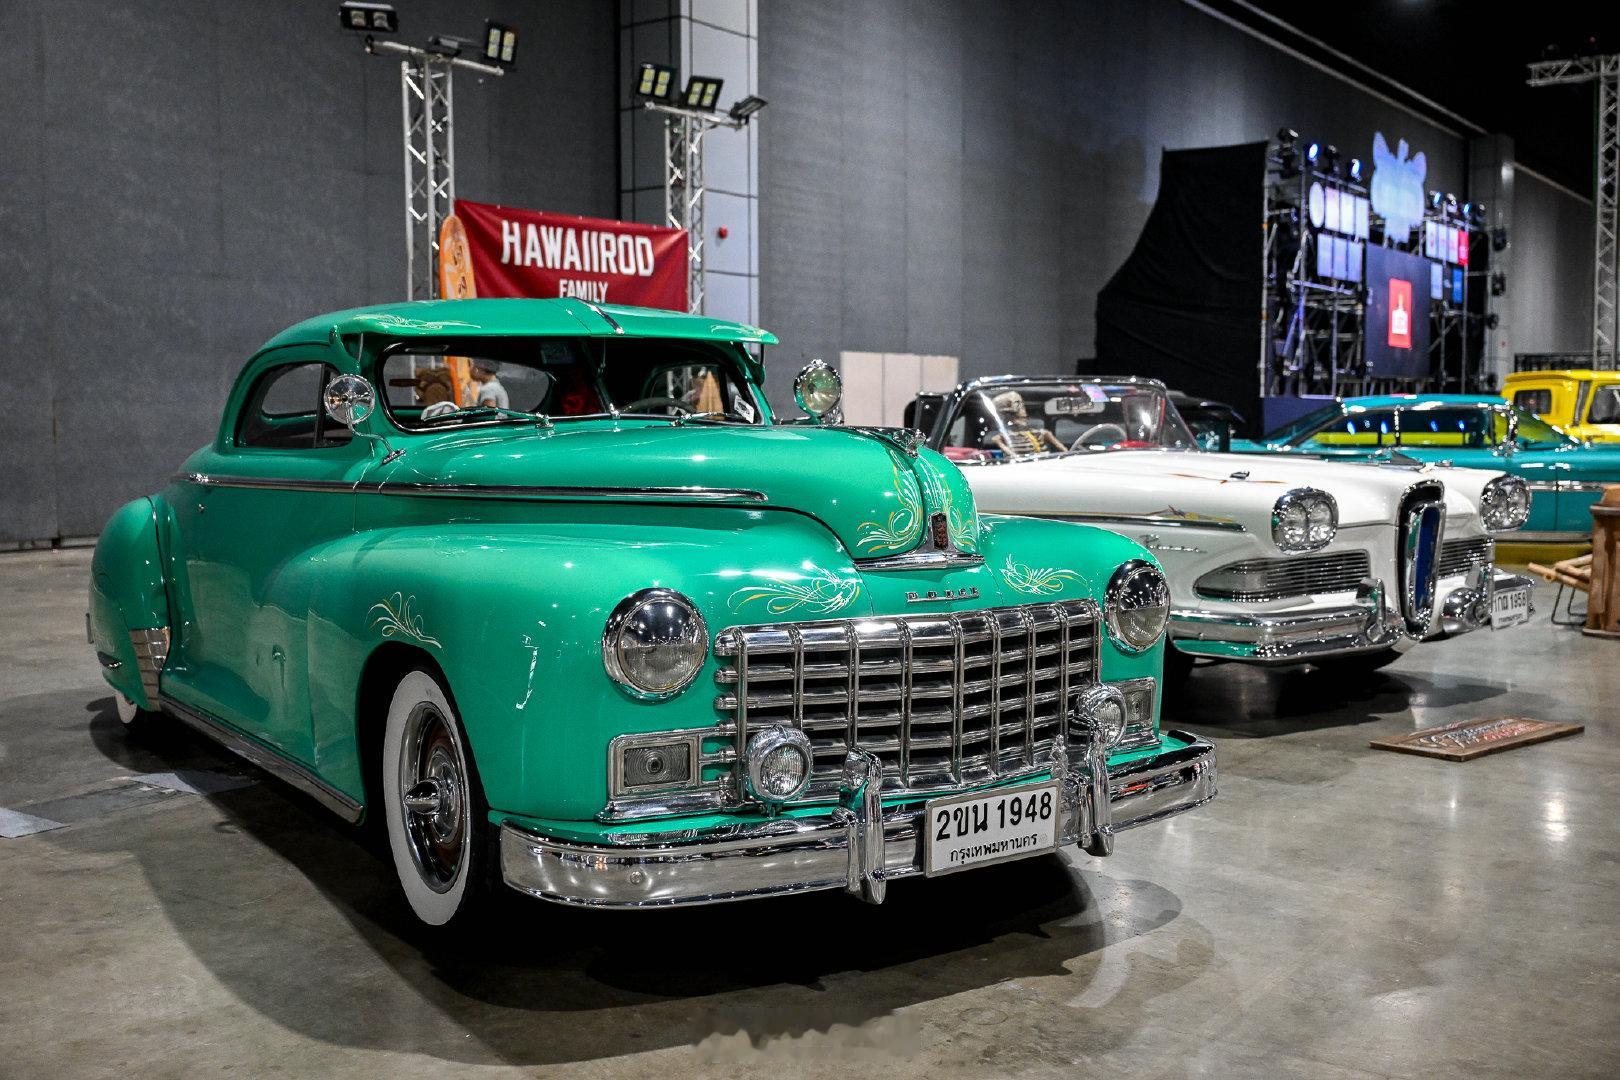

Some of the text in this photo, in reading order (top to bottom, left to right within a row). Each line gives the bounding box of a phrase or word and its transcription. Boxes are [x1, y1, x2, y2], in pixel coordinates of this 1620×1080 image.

[501, 219, 655, 277] HAWAIIROD
[559, 278, 608, 303] FAMILY
[936, 791, 1052, 841] 2ขน 1948
[950, 833, 1038, 864] กรุงเทพมหานคร
